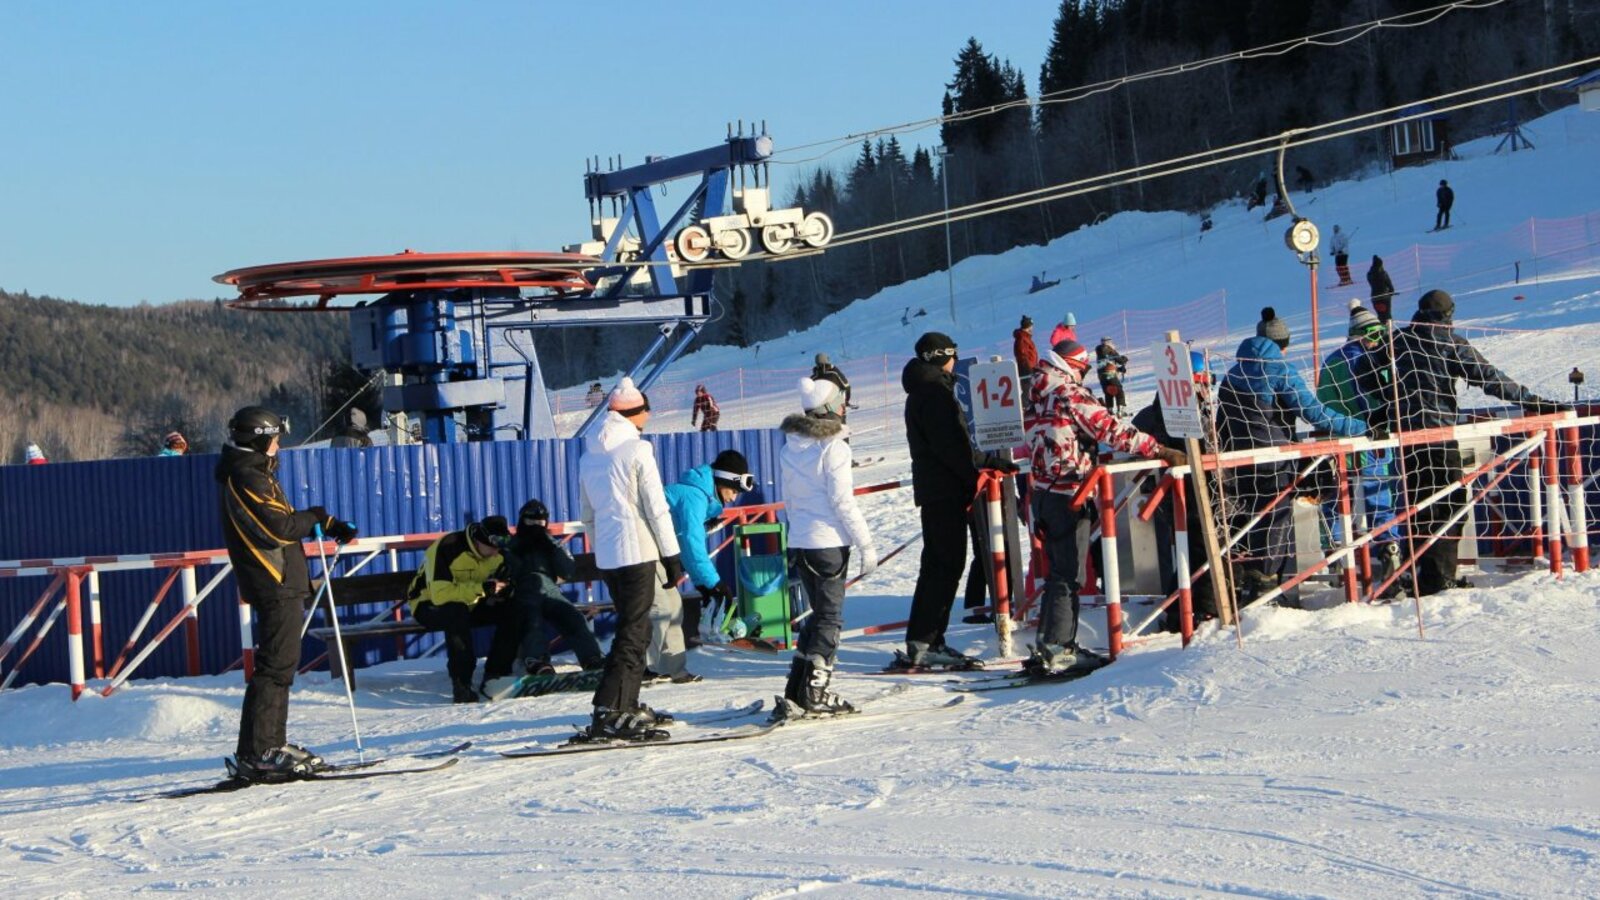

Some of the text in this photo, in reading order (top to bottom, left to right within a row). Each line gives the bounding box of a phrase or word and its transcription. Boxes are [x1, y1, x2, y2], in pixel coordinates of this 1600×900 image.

[1165, 346, 1178, 376] 3
[976, 375, 1014, 410] 1-2
[1159, 379, 1192, 407] VIP
